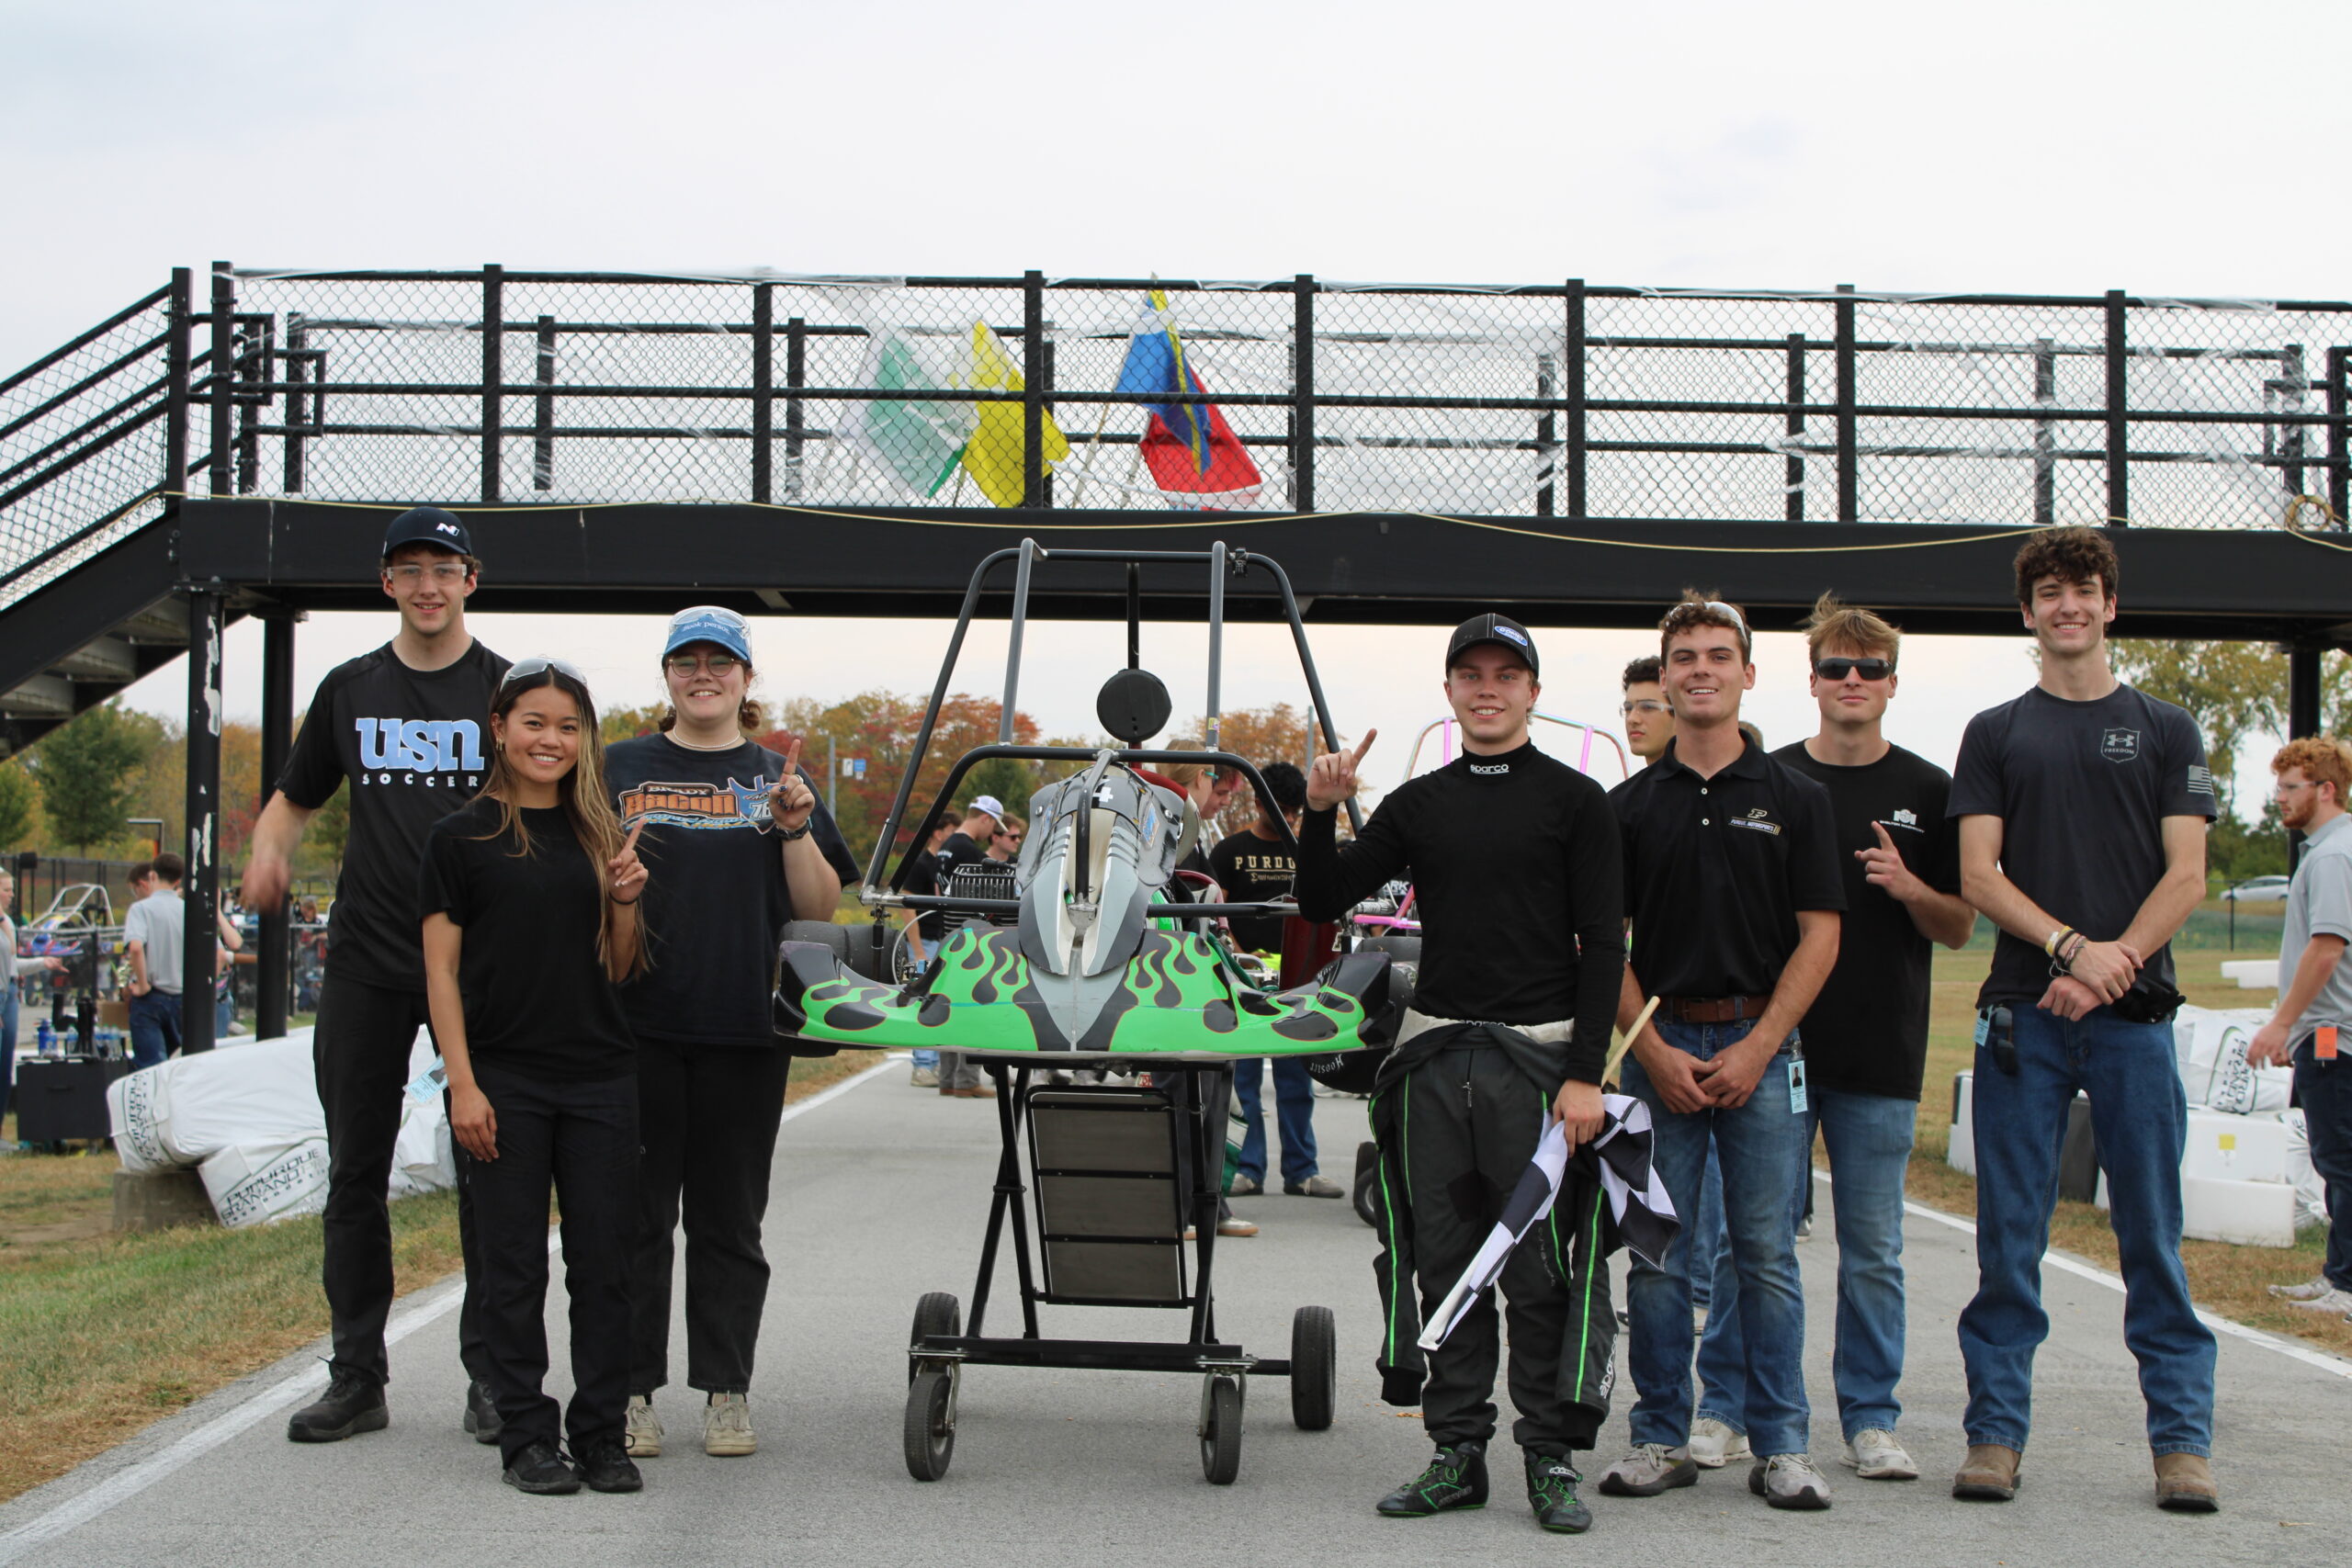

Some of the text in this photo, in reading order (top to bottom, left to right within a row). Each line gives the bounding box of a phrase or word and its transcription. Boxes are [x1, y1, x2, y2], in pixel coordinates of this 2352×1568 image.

[362, 773, 478, 787] SOCCER
[649, 785, 708, 795] BRADY
[1235, 855, 1296, 870] PURDU
